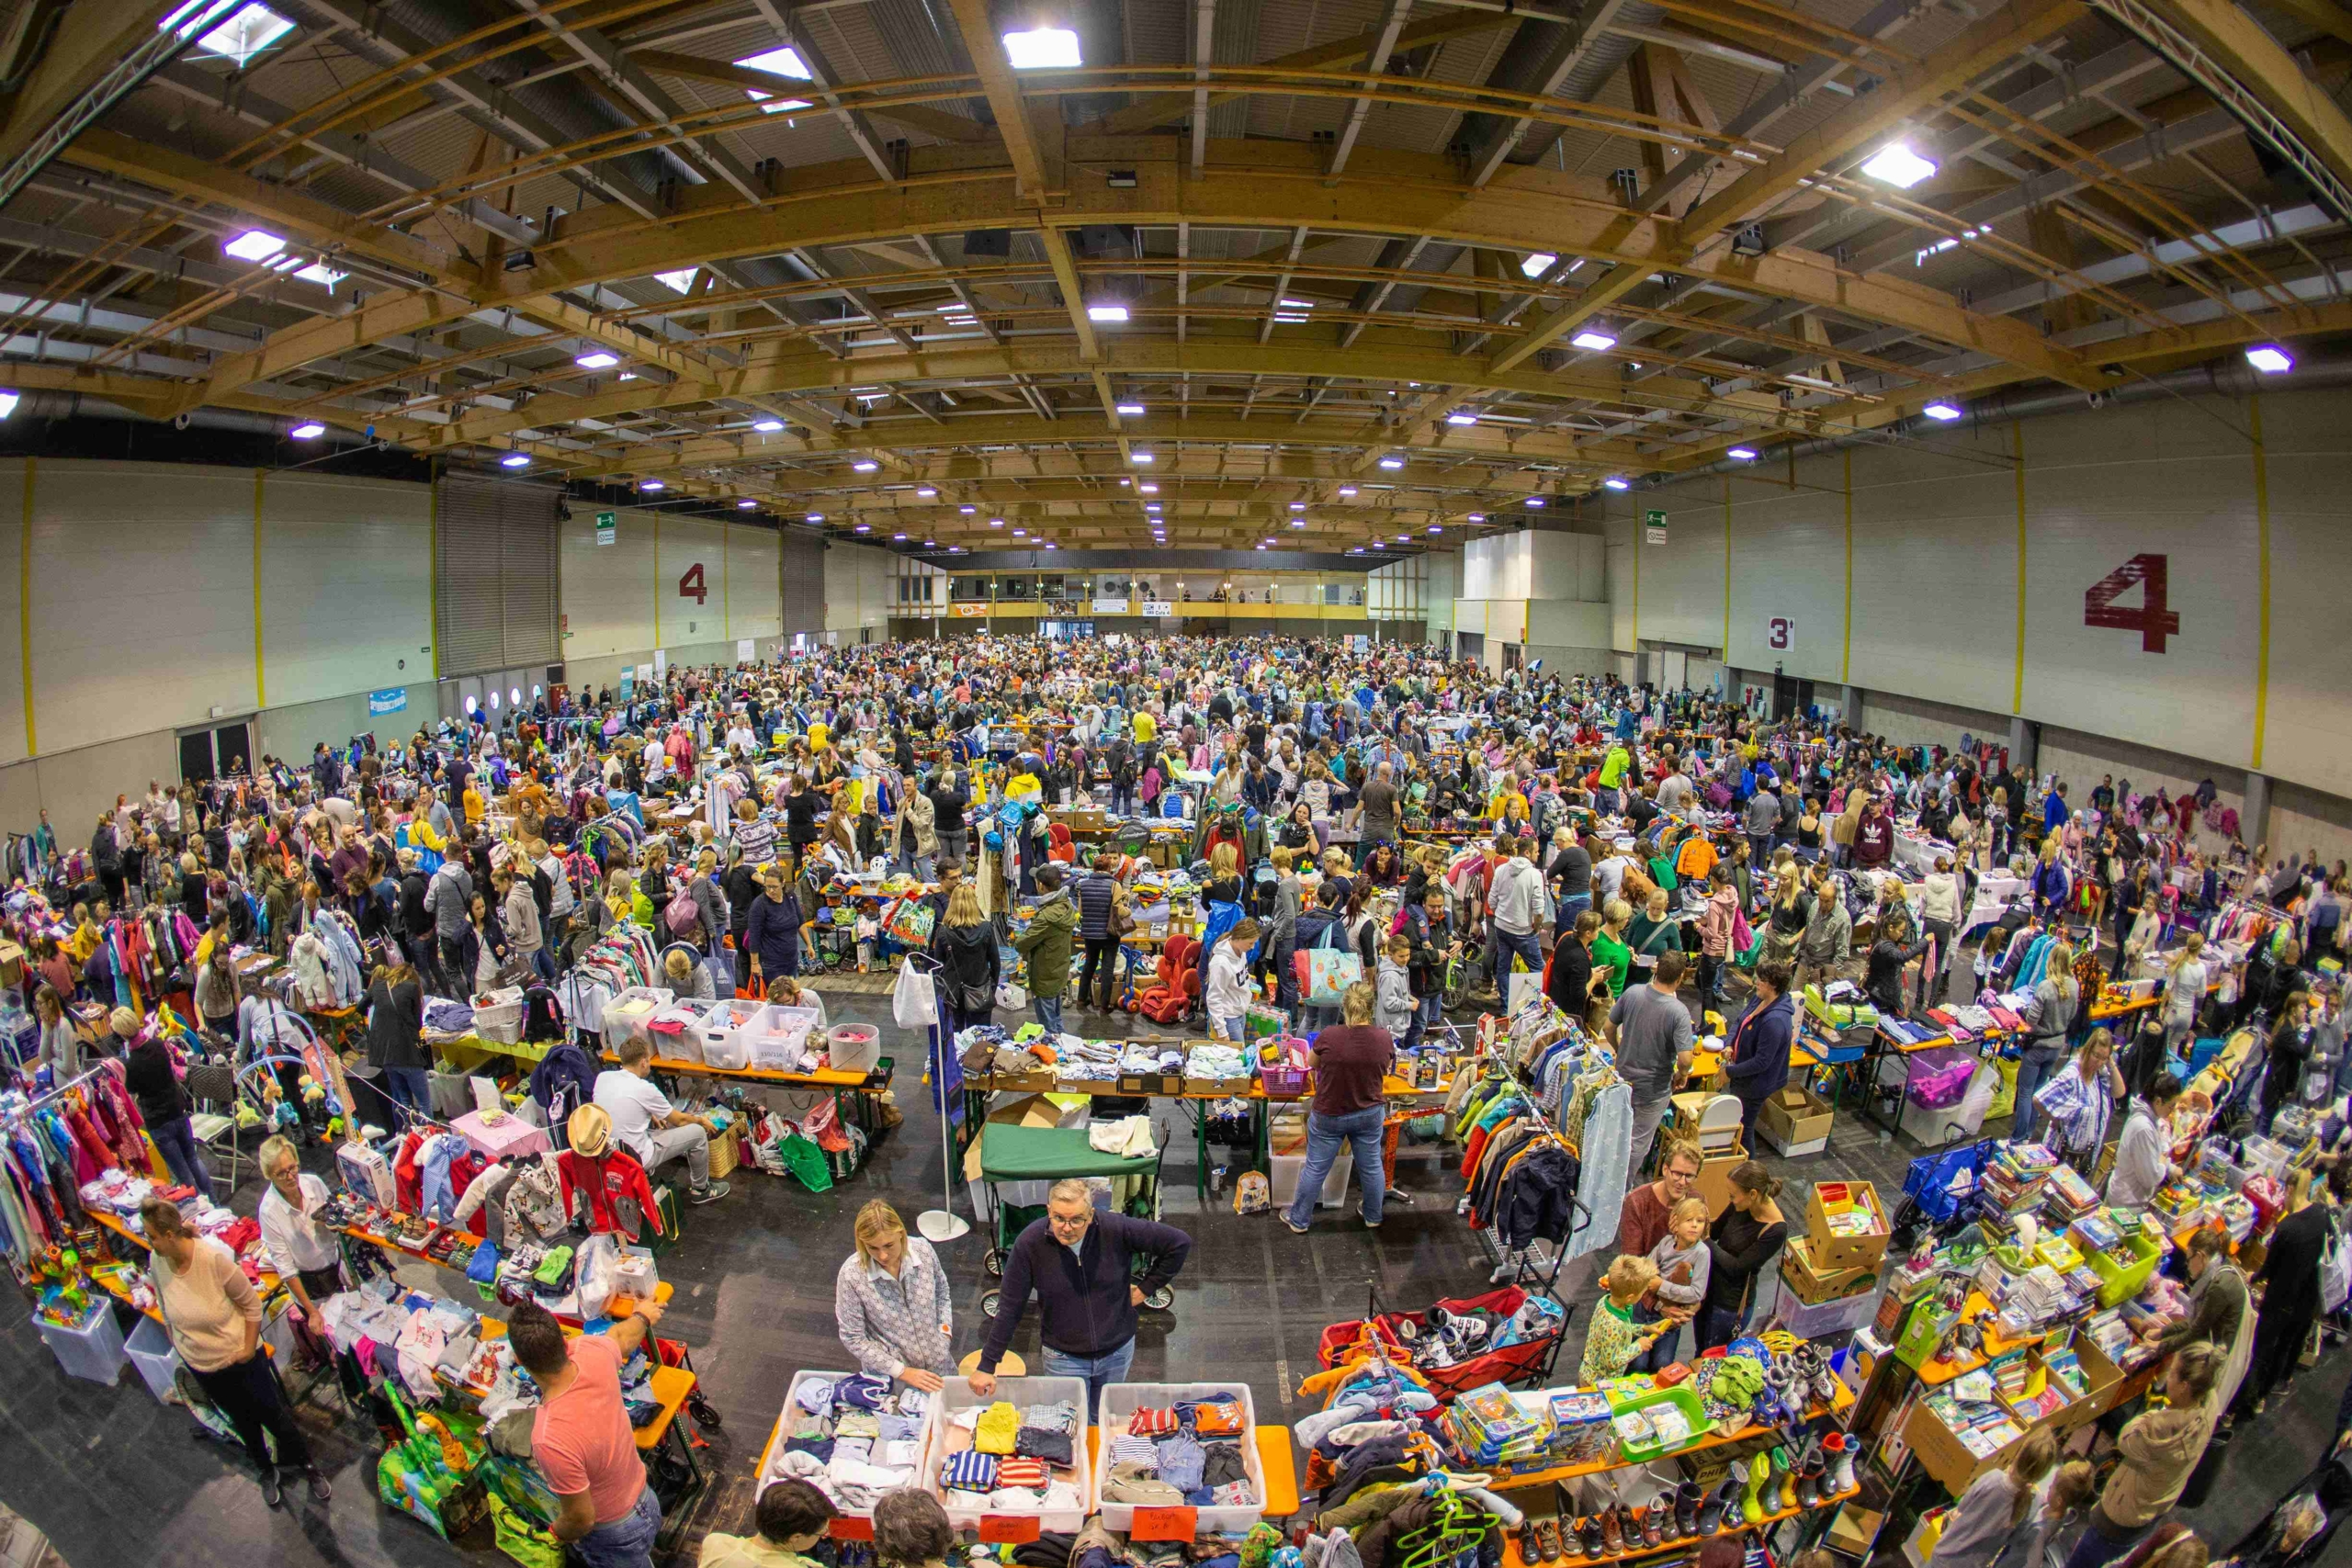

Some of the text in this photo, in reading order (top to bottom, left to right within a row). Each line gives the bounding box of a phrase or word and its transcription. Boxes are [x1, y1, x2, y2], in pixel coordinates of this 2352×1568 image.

[679, 562, 707, 605] 4
[2085, 553, 2180, 654] 4
[1770, 617, 1788, 649] 3
